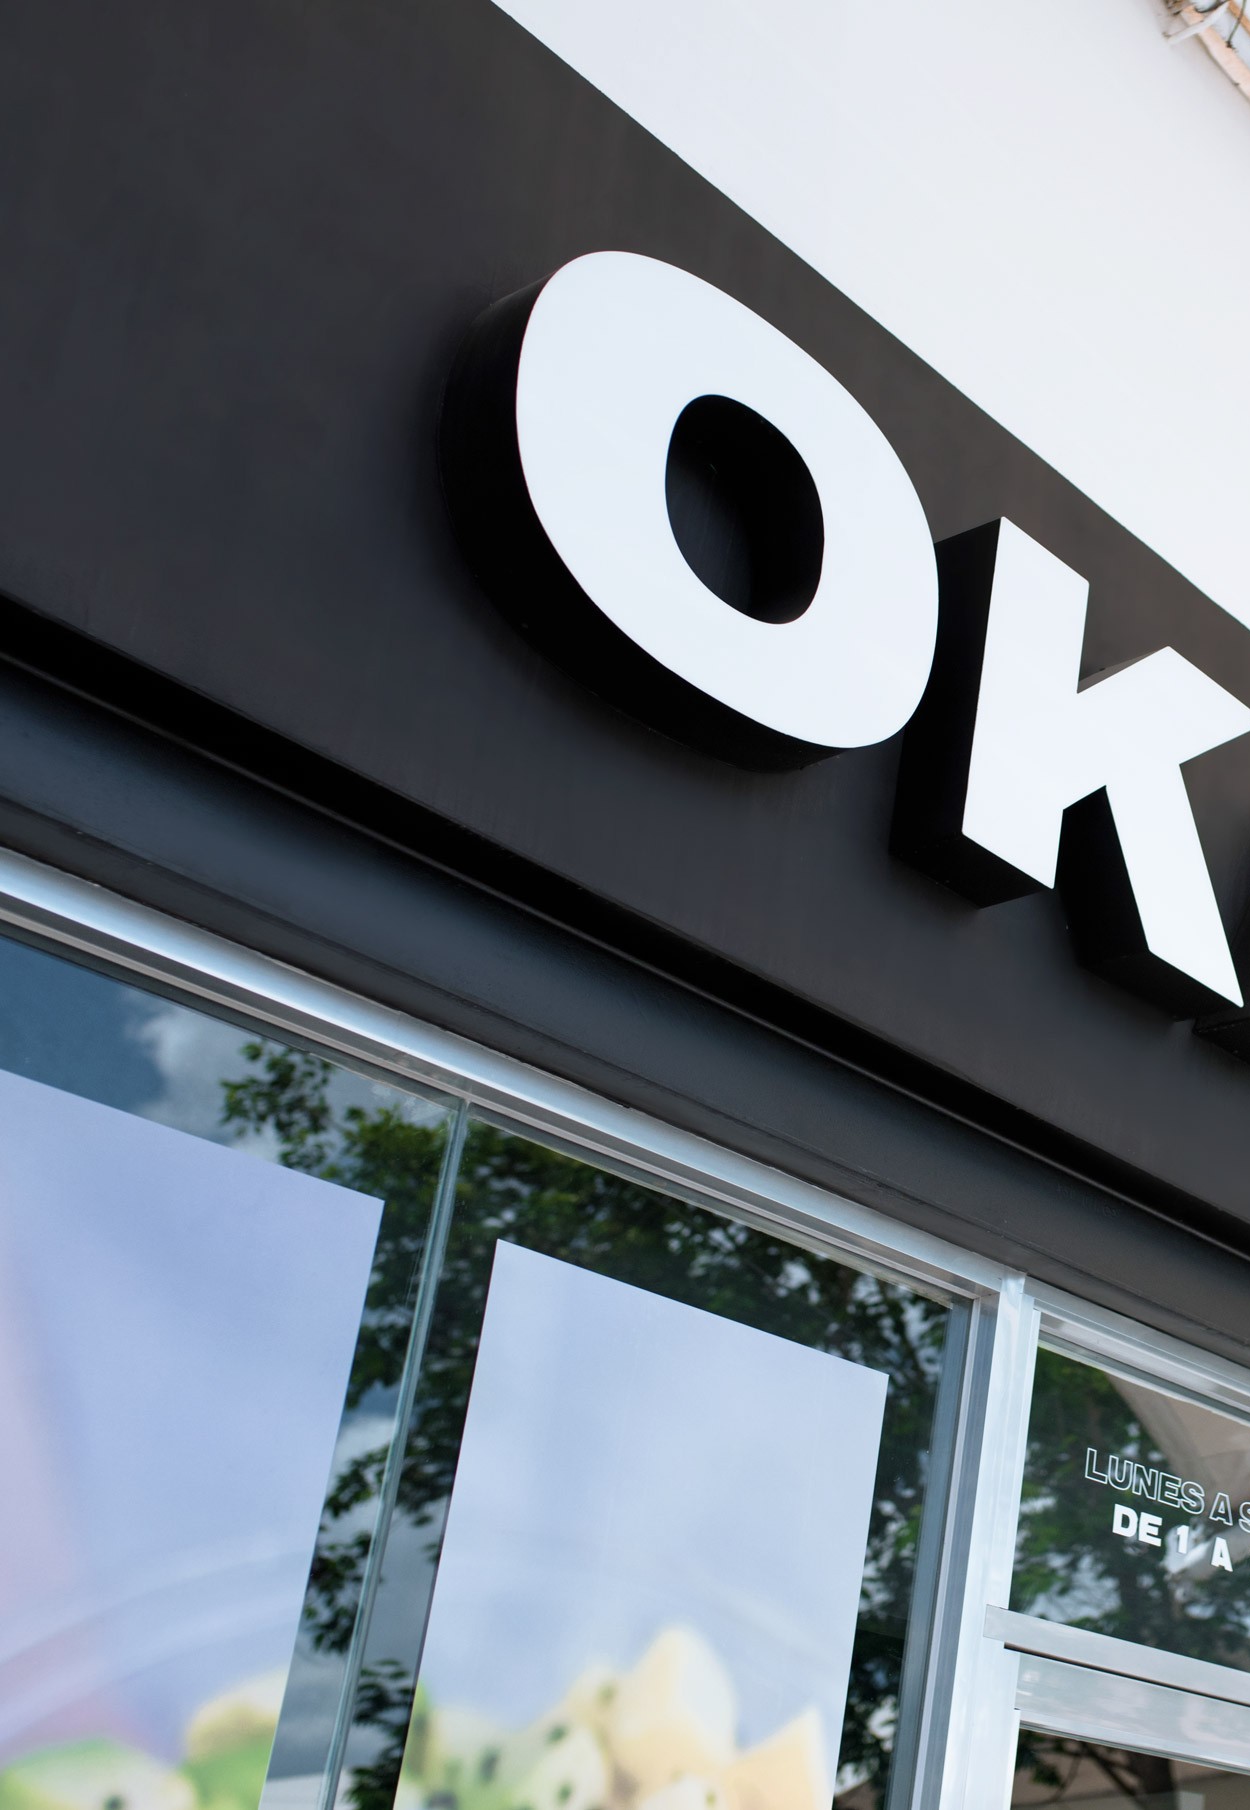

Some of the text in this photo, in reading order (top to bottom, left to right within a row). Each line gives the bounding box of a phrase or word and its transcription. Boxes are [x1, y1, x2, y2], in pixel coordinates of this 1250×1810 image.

[1084, 1447, 1206, 1515] LUNES
[1209, 1491, 1234, 1527] A
[1111, 1503, 1163, 1547] DE
[1175, 1524, 1190, 1555] 1
[1210, 1536, 1234, 1573] A
